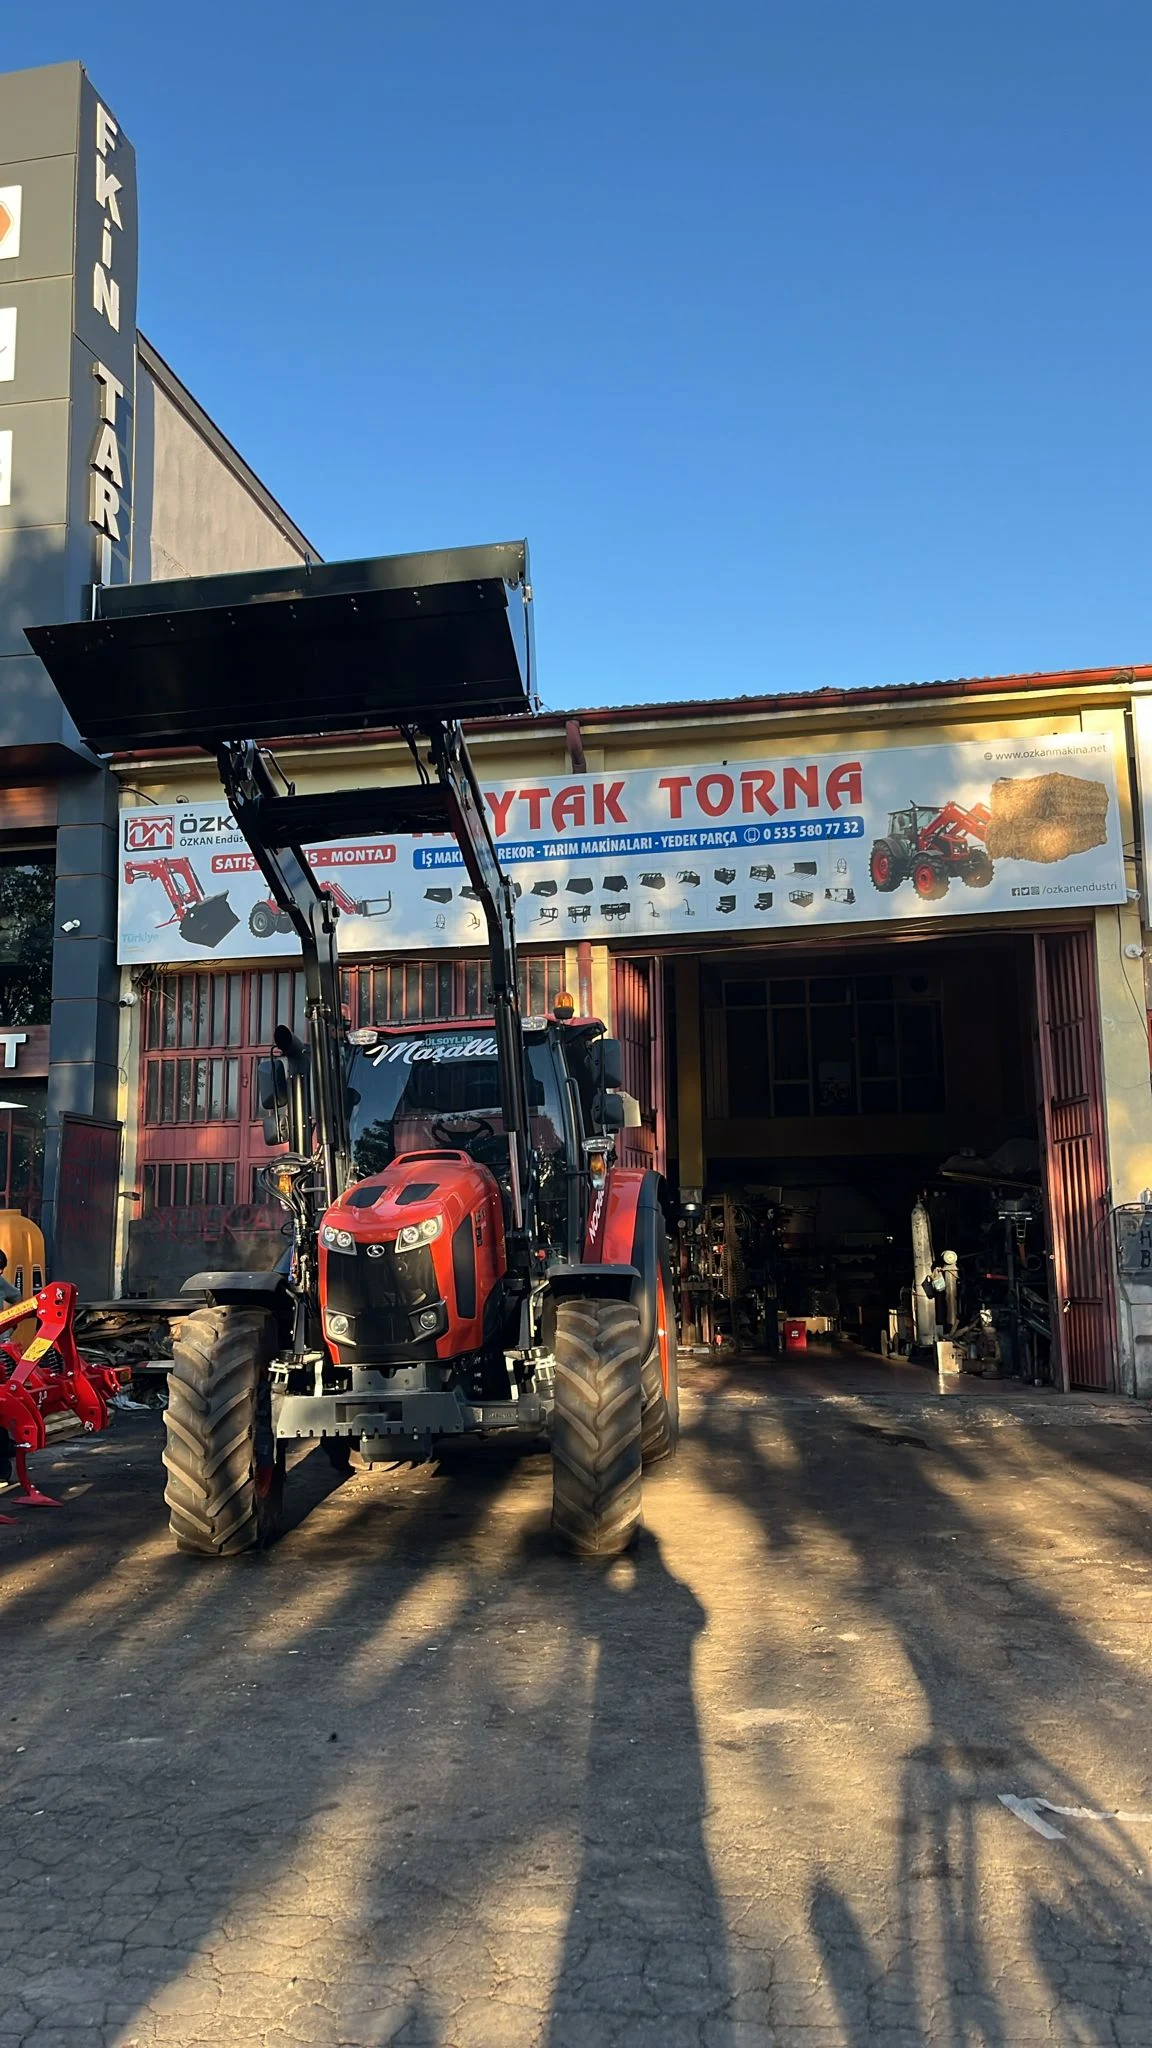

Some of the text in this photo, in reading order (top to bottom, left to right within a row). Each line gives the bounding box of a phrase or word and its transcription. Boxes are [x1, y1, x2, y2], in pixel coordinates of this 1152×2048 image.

[89, 362, 124, 586] TARI
[995, 744, 1106, 760] www.ozkanmakina.net
[411, 762, 863, 840] YTAK TORNA
[180, 813, 240, 834] ÖZK
[180, 834, 246, 847] ÖZKAN Endüs
[421, 851, 433, 867] İŞ
[542, 843, 579, 857] TARIM
[580, 837, 652, 854] MAKİNALARI
[661, 835, 698, 848] YEDEK
[700, 831, 738, 847] PARÇA
[763, 830, 771, 840] 0
[773, 827, 797, 839] 535
[799, 825, 823, 837] 580
[825, 823, 841, 835] 77
[843, 821, 859, 834] 32
[215, 856, 255, 871] SATIŞ
[331, 848, 392, 863] MONTAJ
[365, 1037, 498, 1067] Maşalla
